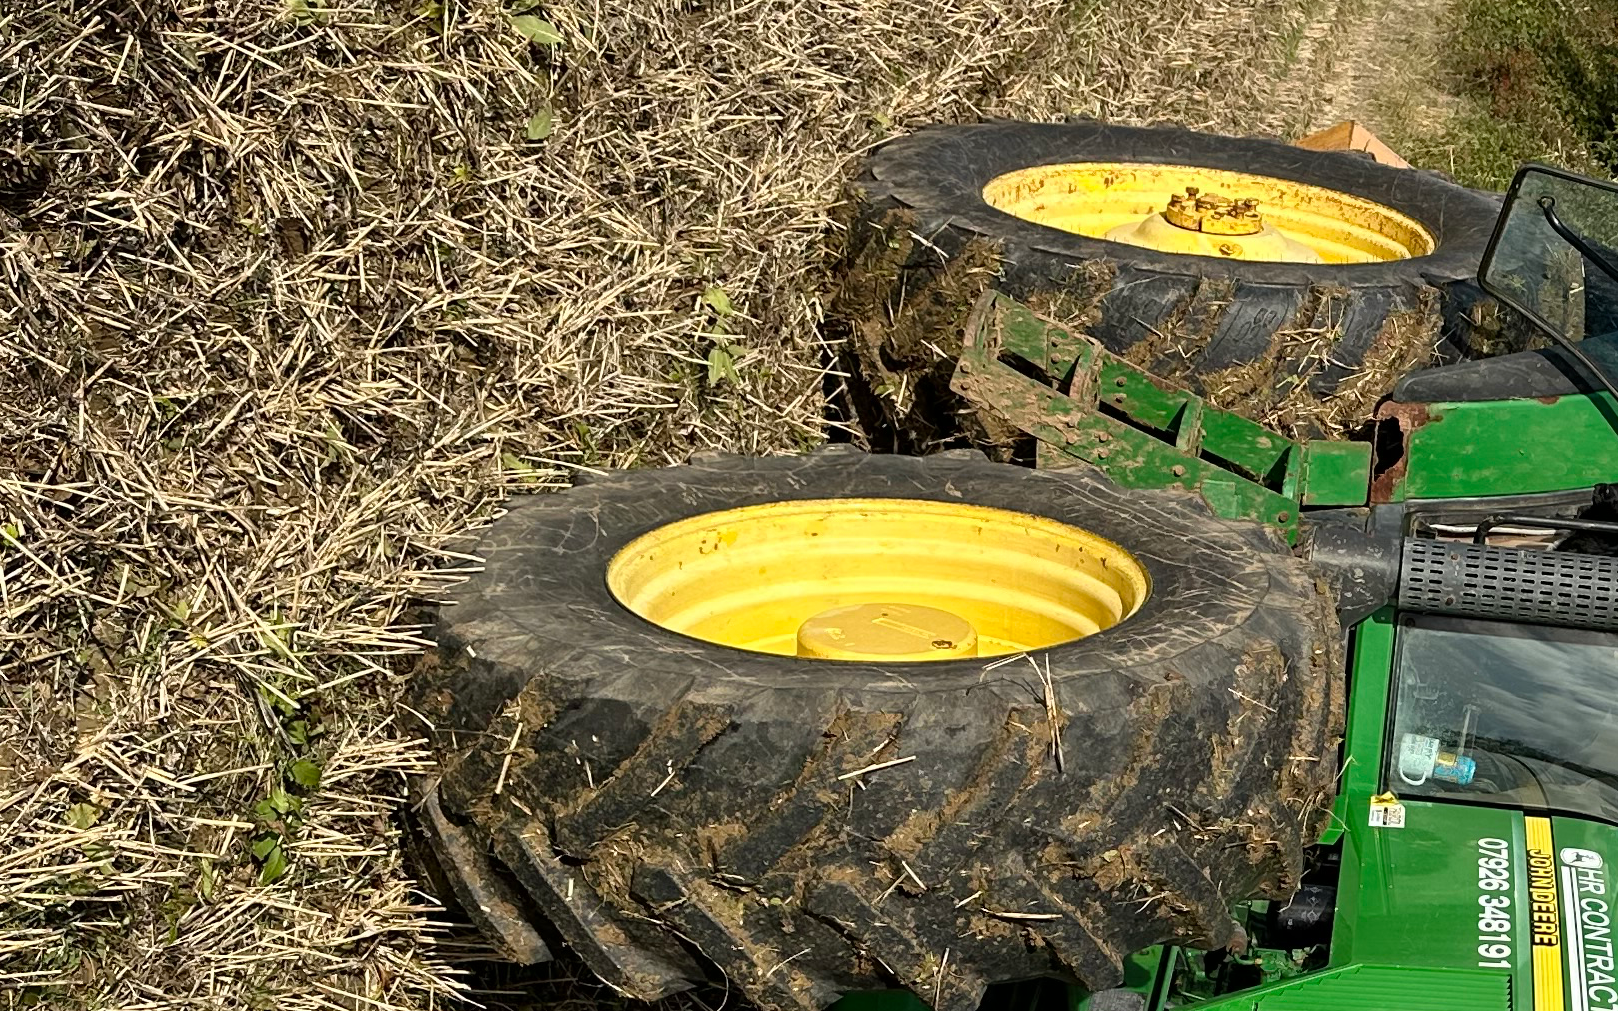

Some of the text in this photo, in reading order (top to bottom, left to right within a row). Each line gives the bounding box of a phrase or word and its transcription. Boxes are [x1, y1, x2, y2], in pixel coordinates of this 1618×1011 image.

[1477, 837, 1512, 969] 07926 348191
[1528, 849, 1559, 947] JOHN DEERE
[1578, 867, 1606, 895] HR
